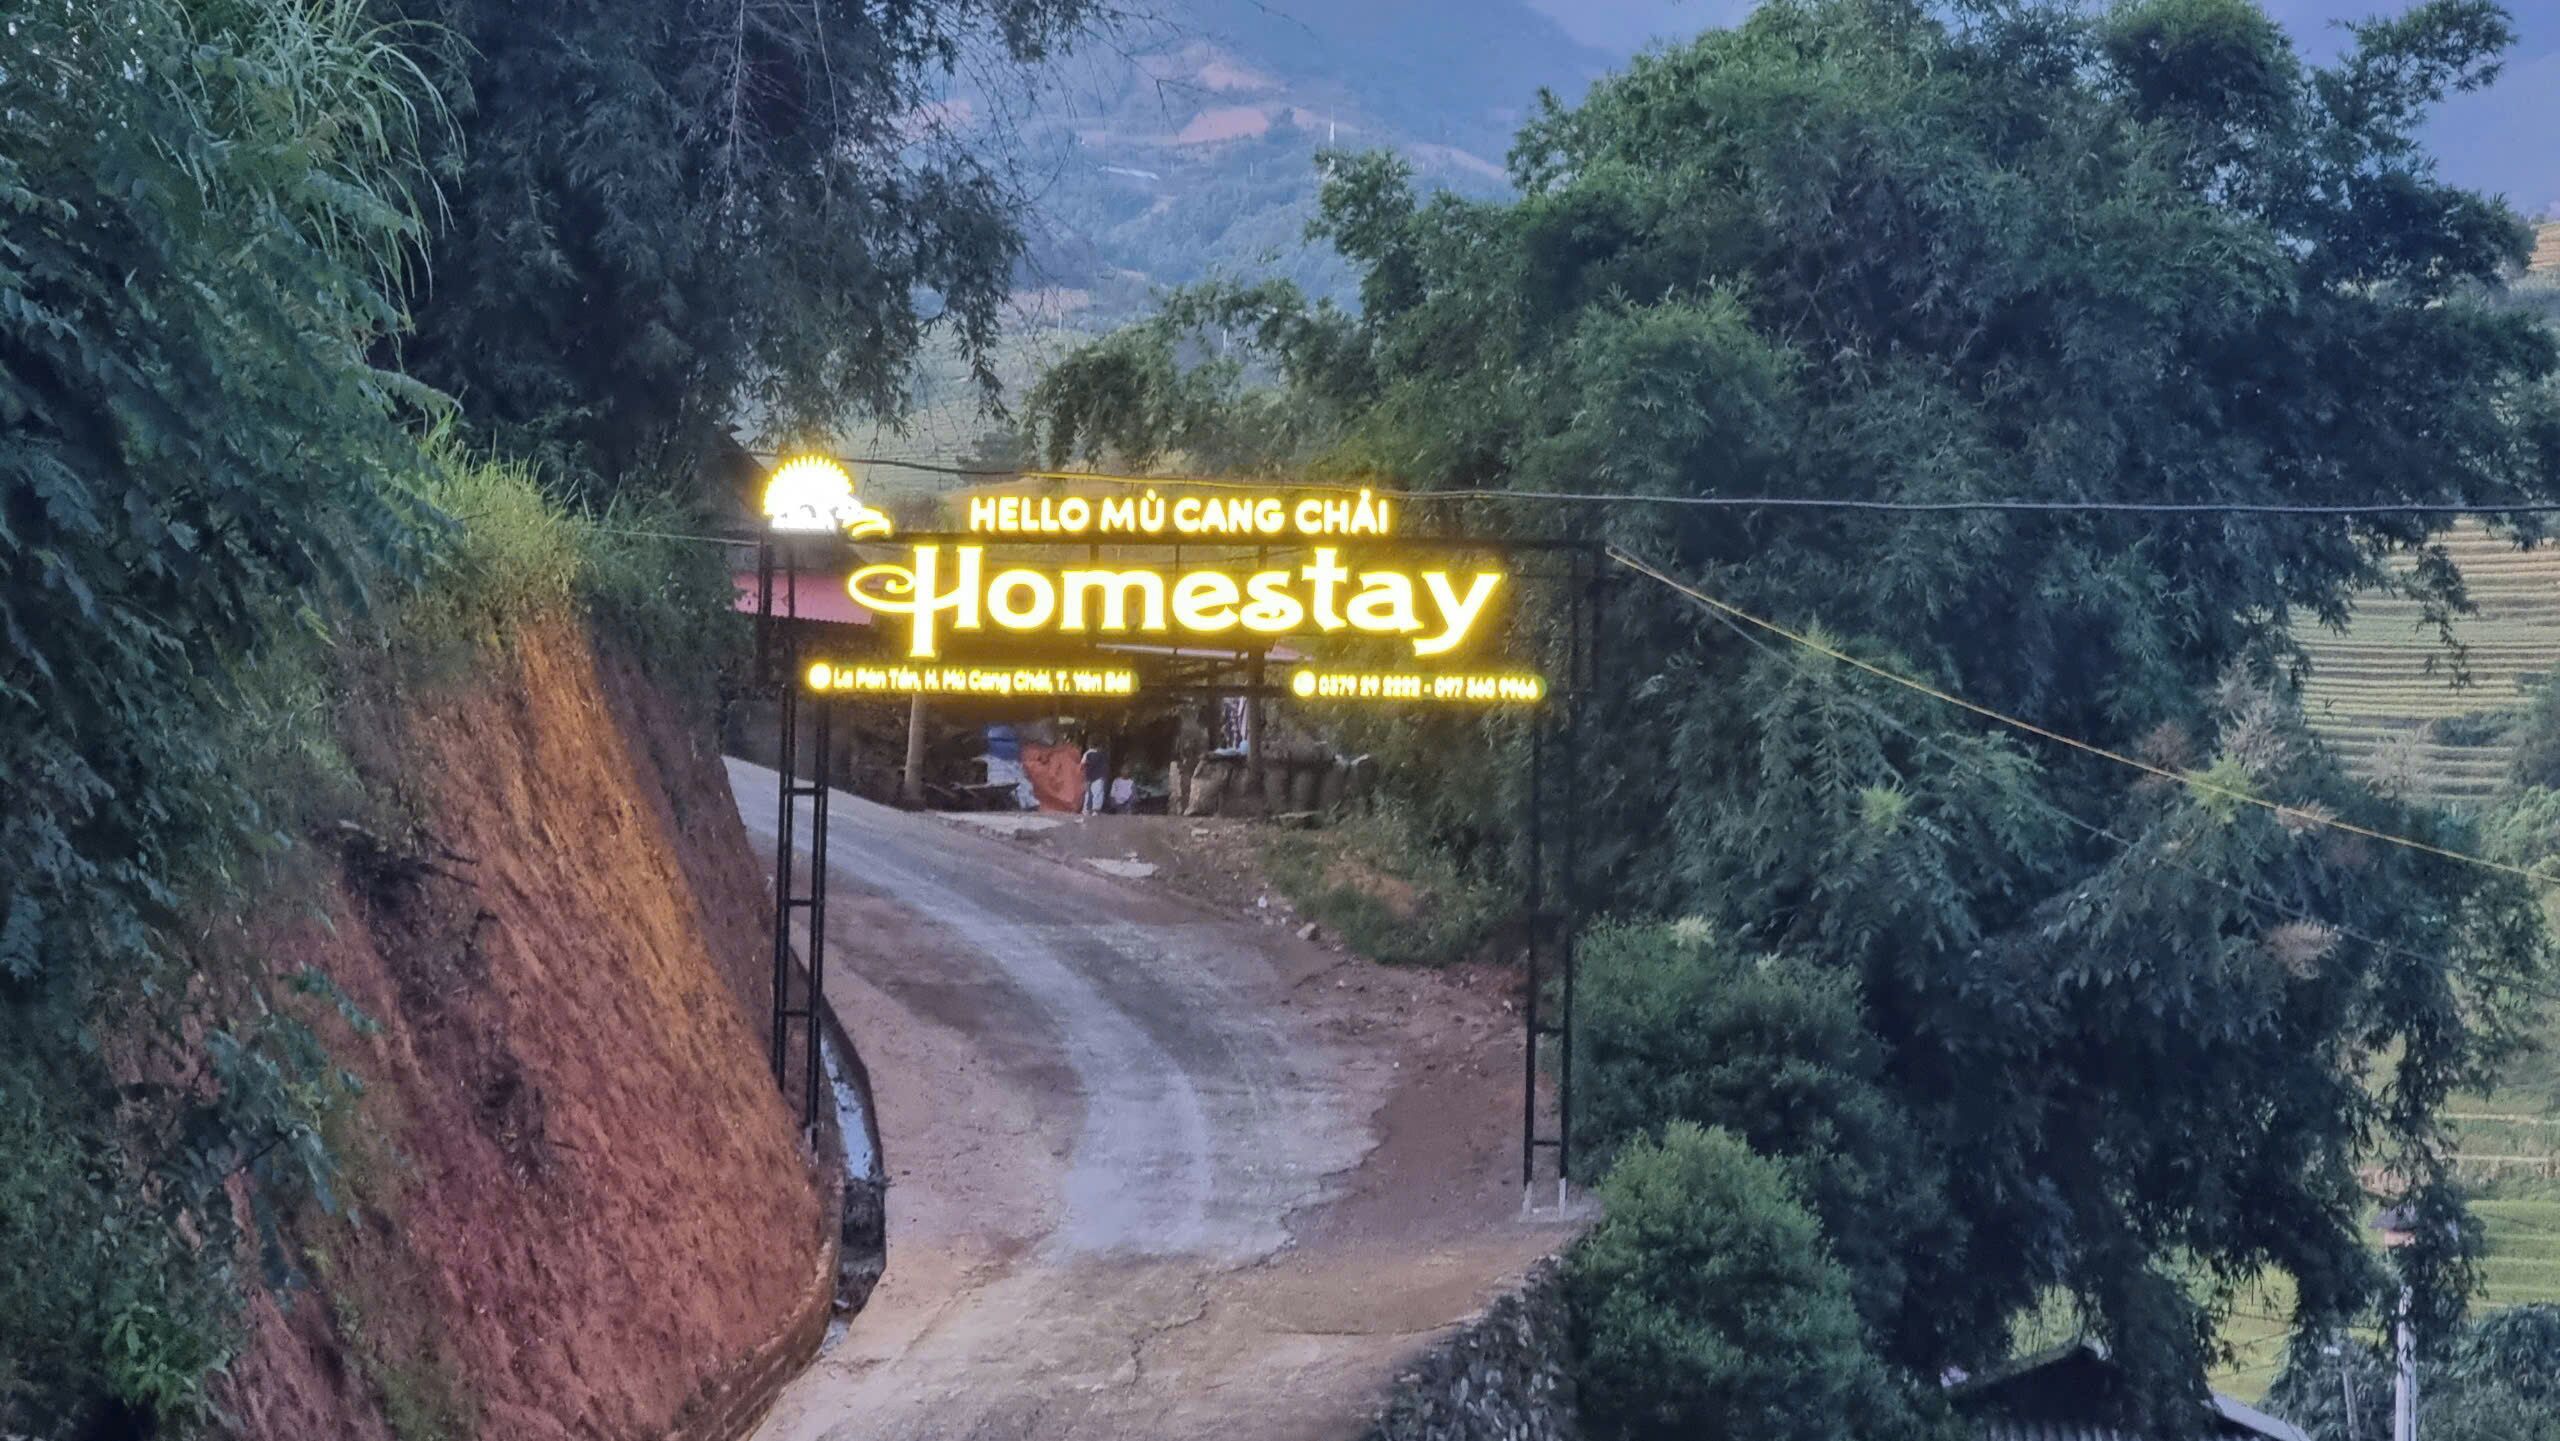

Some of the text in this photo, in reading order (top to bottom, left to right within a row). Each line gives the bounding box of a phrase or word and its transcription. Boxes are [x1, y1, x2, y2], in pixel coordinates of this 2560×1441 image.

[969, 495, 1092, 533] HELLO
[1099, 488, 1168, 533] MÙ
[1172, 496, 1288, 534] CANG
[847, 545, 1501, 656] Homestay
[967, 669, 1012, 695] Cang
